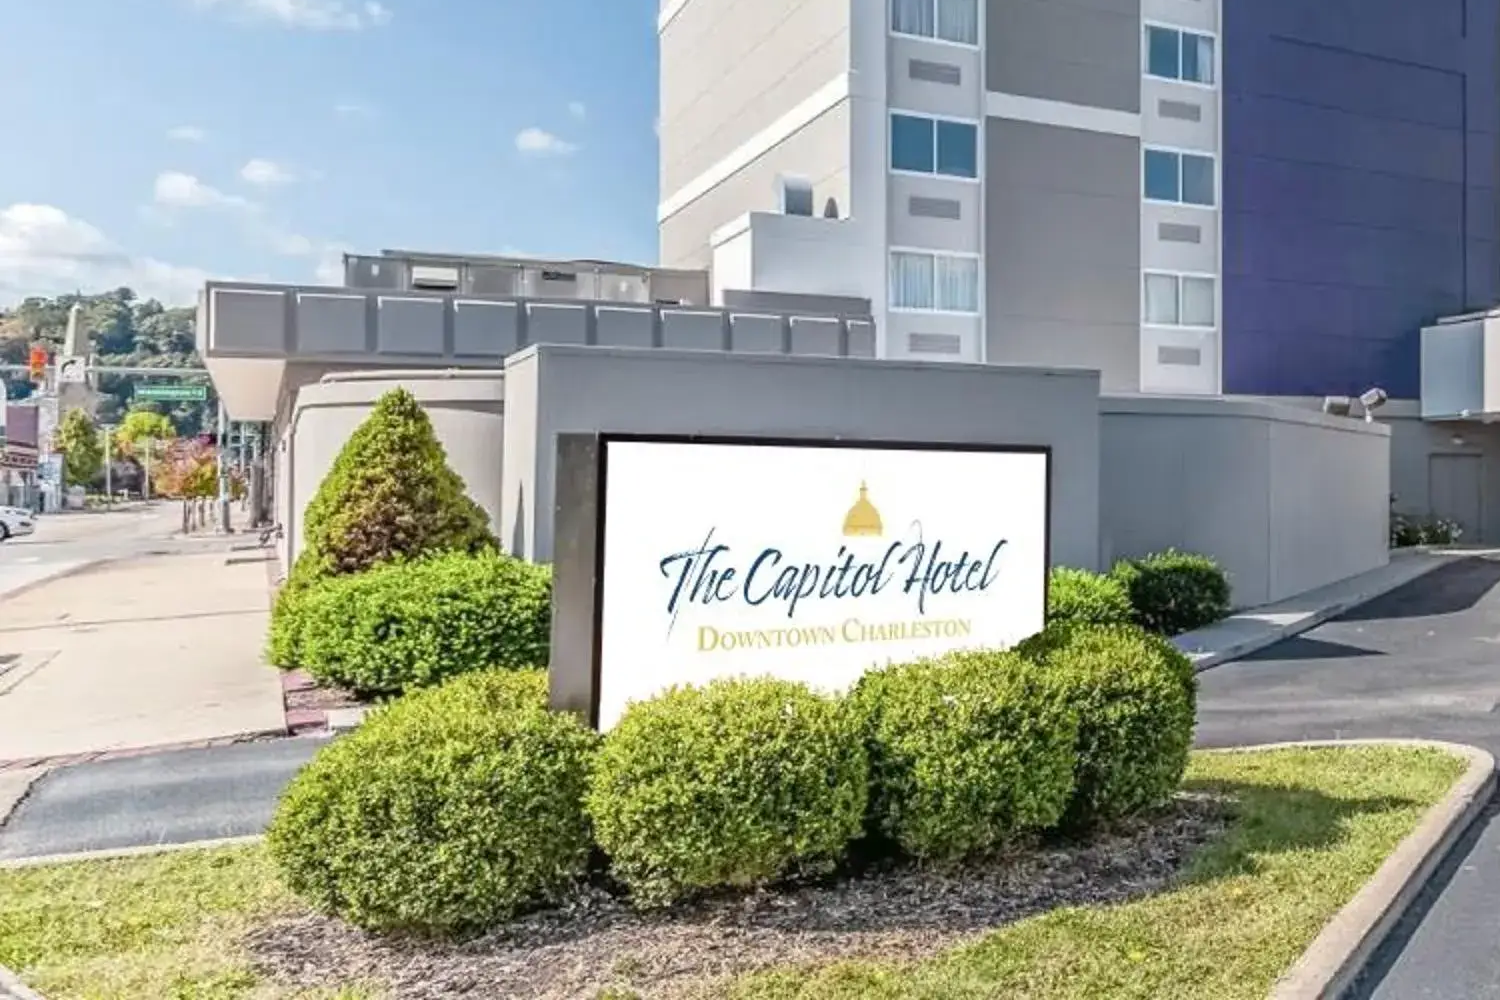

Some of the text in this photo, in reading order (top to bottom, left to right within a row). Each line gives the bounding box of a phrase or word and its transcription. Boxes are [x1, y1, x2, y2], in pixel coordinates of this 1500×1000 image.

[659, 519, 1008, 642] The Capitol Hotel
